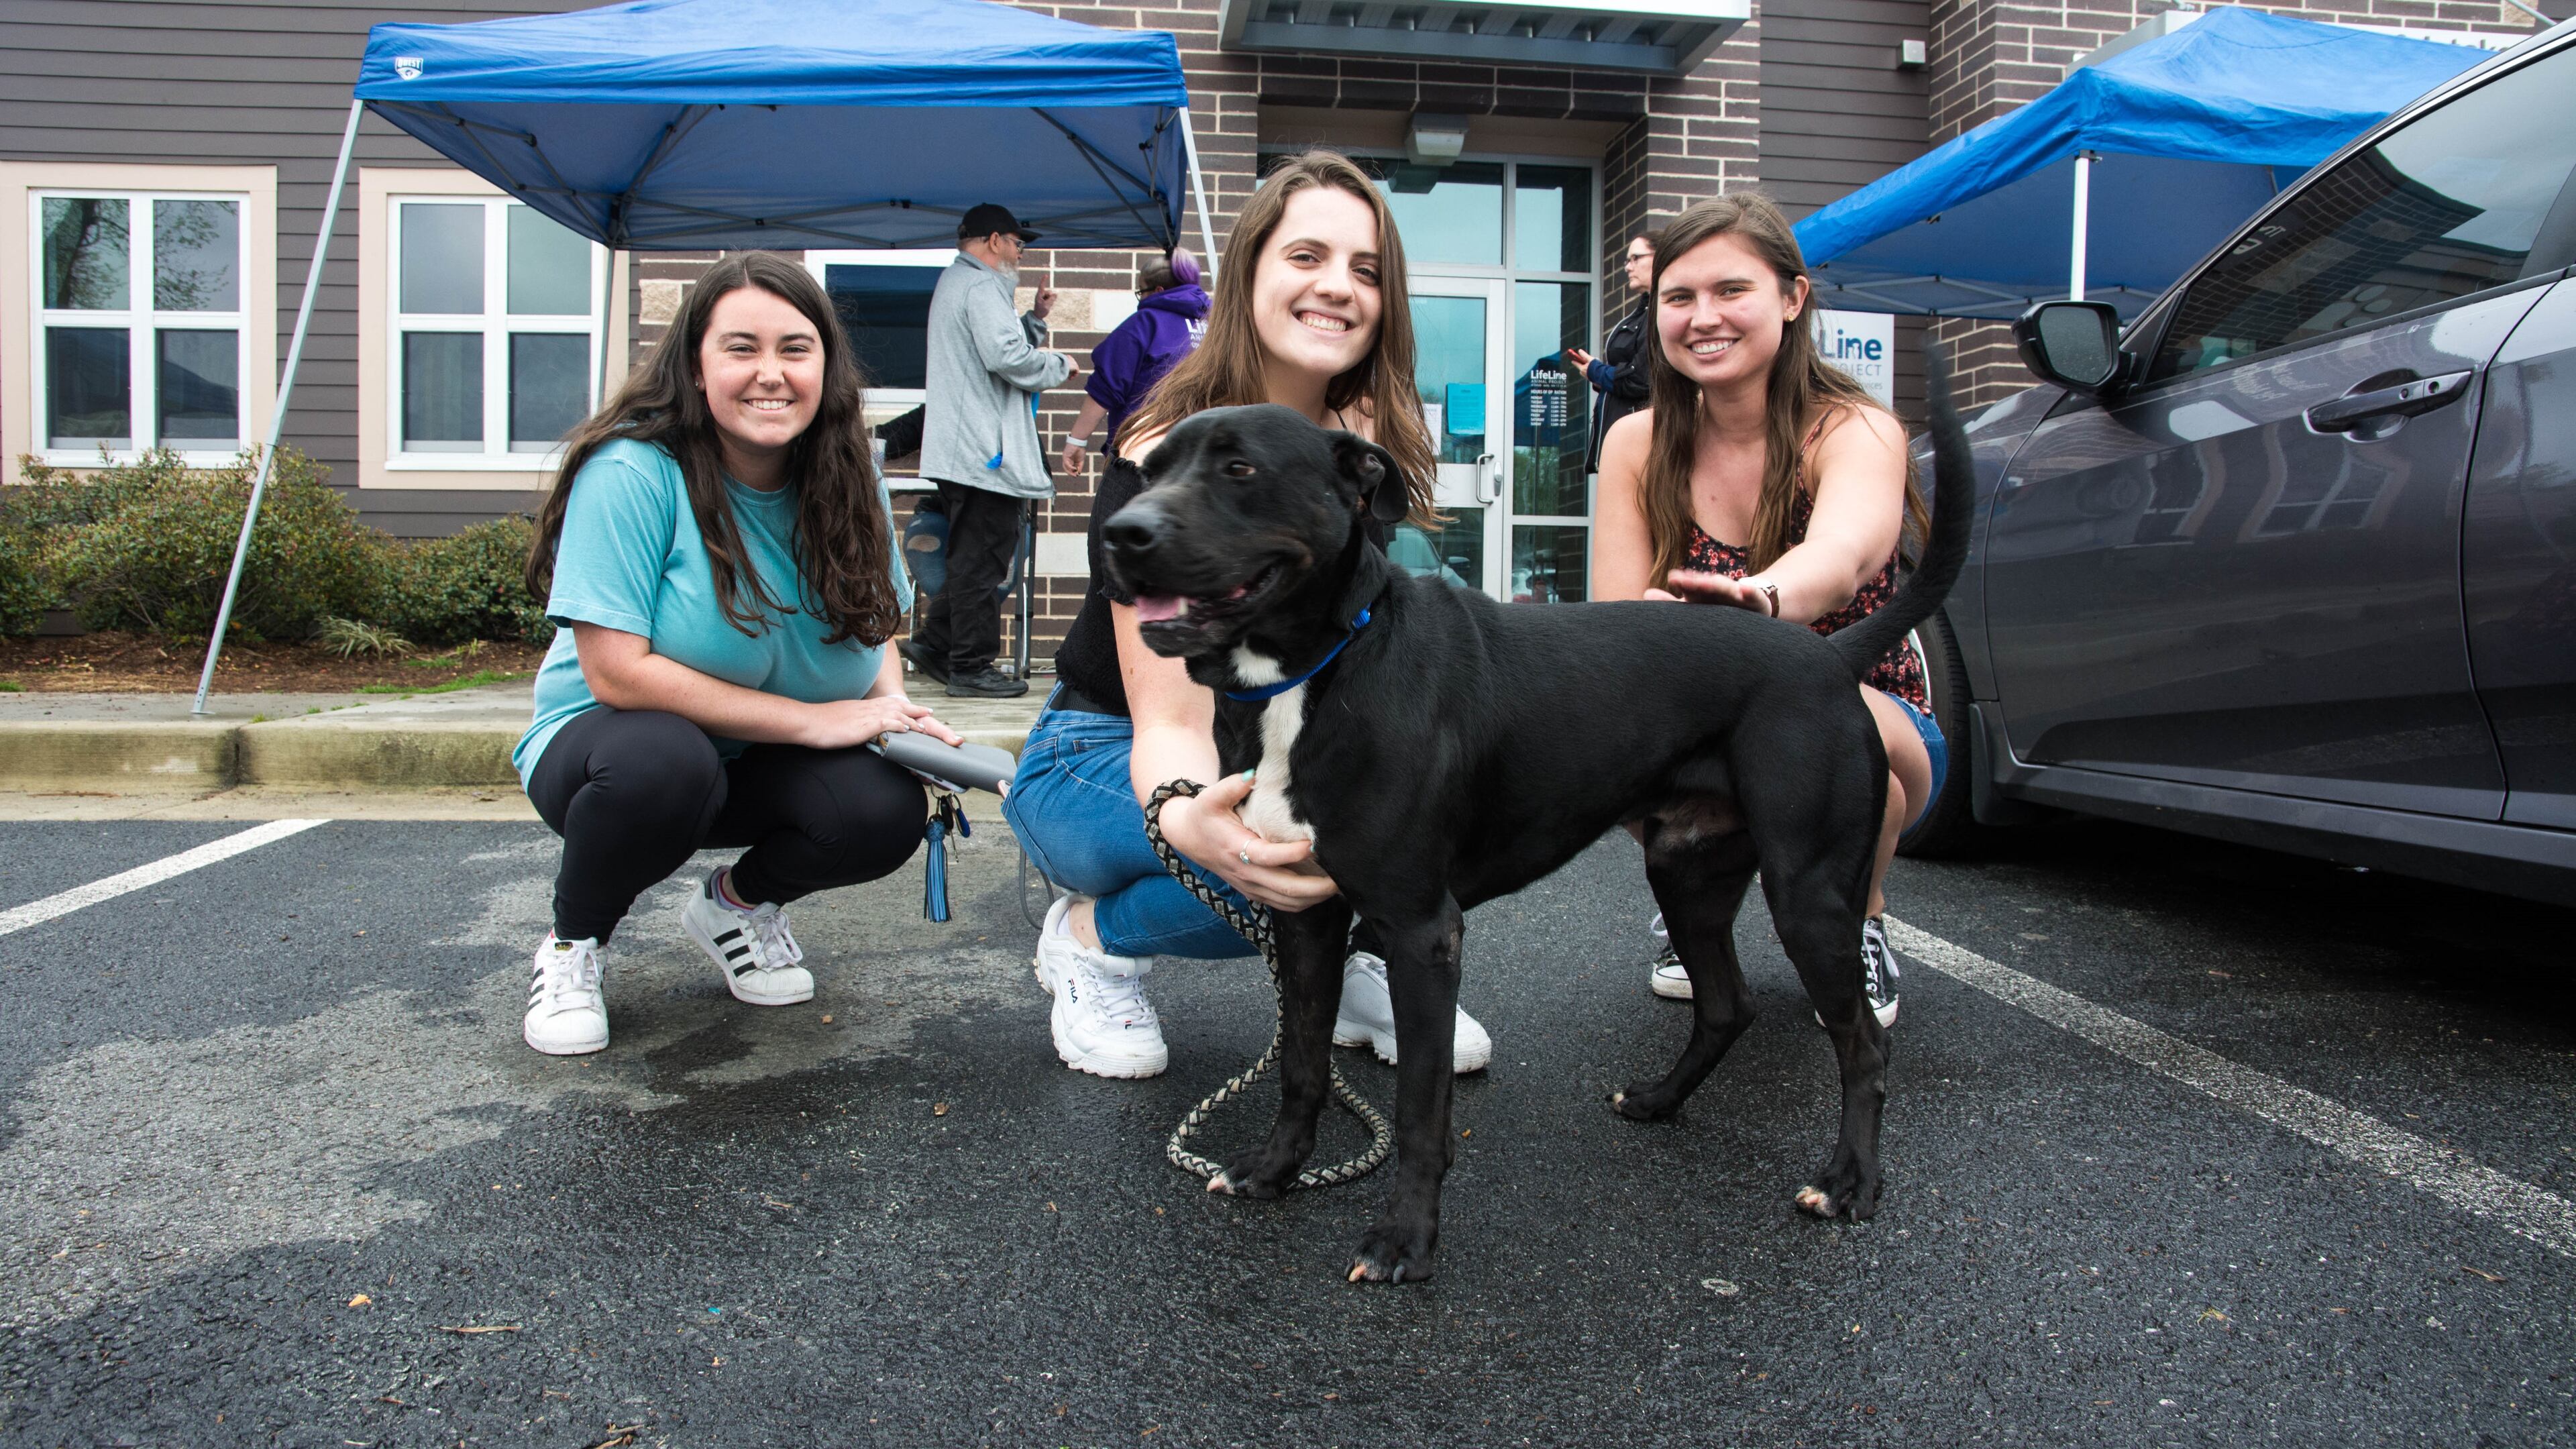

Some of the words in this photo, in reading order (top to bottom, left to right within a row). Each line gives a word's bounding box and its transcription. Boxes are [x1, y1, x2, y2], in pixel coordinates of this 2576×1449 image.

[1819, 329, 1882, 360] Line
[1531, 370, 1567, 380] LifeLine
[1068, 978, 1078, 1004] FILA
